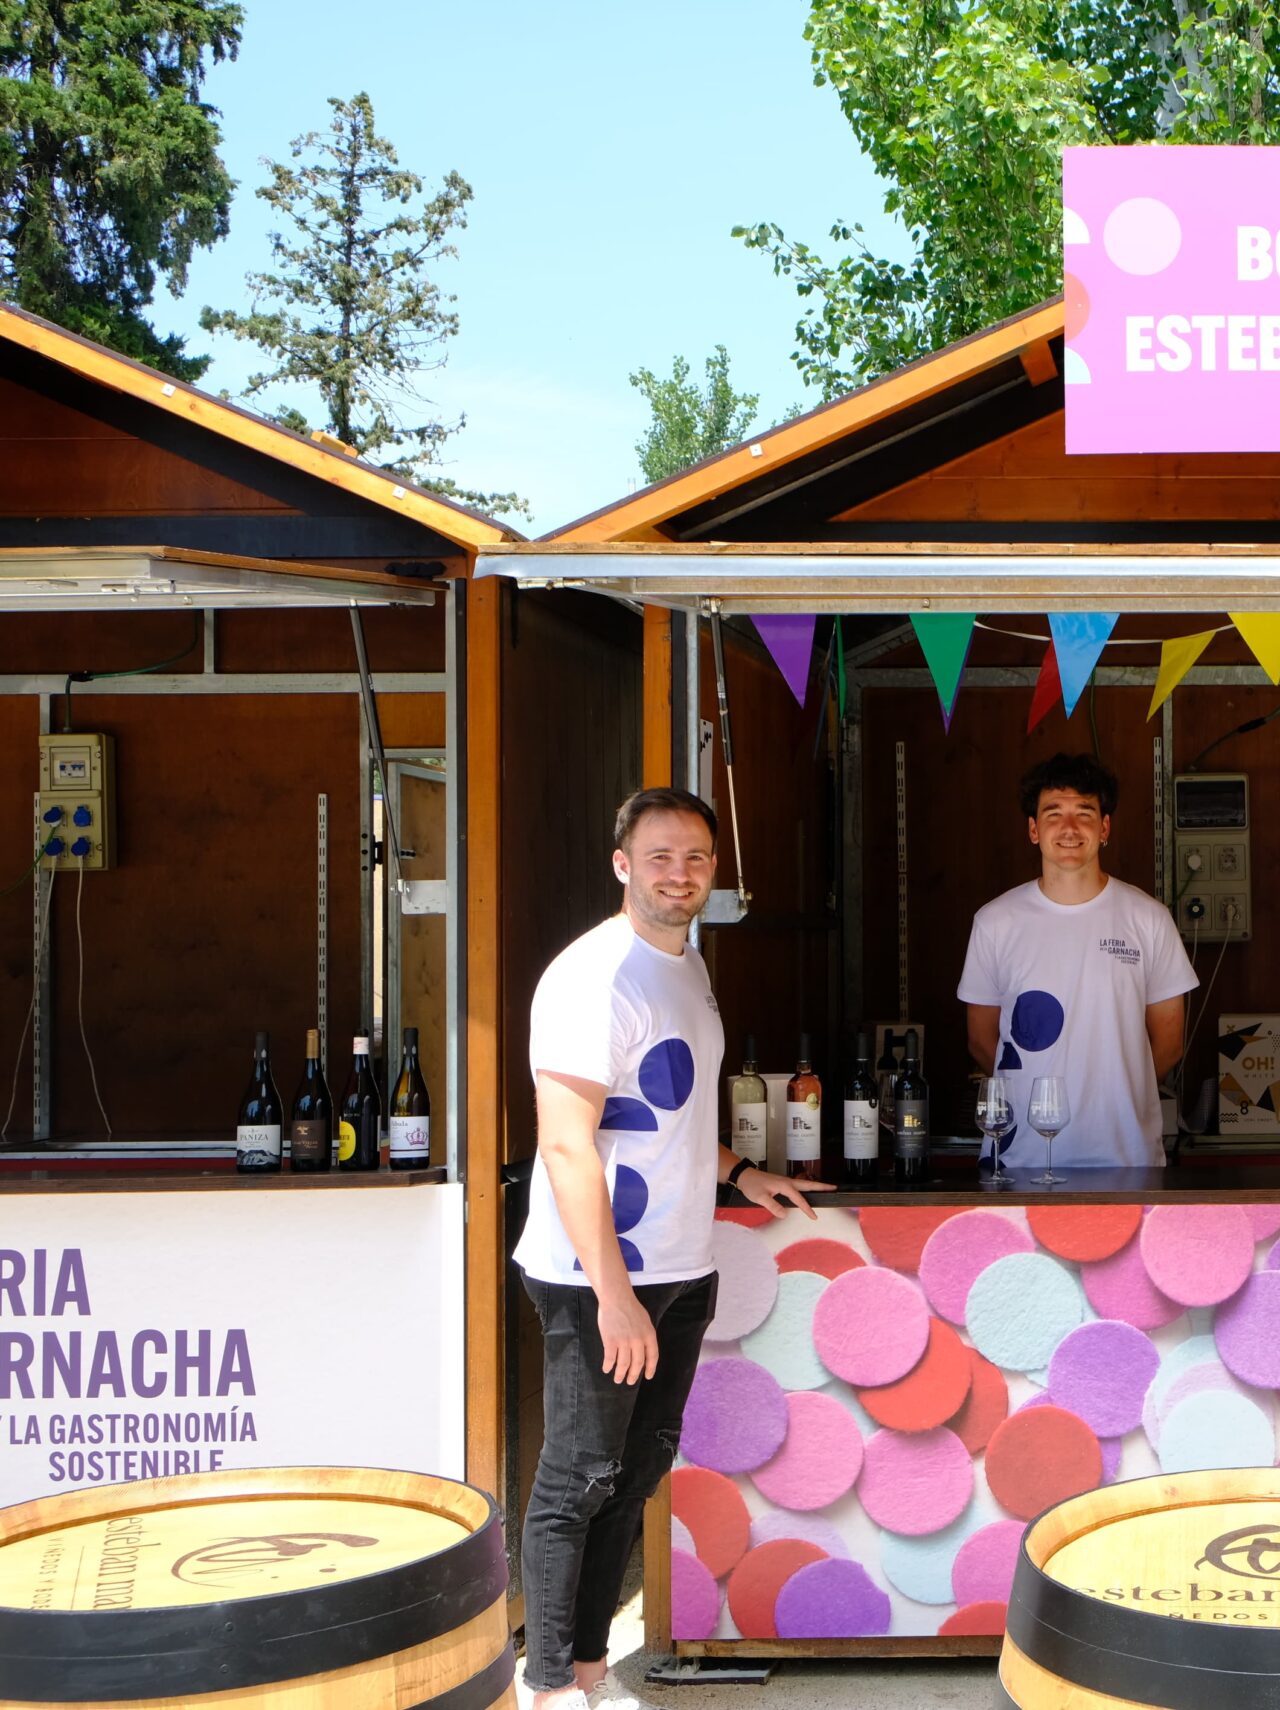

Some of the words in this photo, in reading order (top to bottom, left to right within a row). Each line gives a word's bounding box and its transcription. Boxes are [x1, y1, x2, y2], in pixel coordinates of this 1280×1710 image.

[1100, 939, 1108, 947] LA
[1108, 938, 1126, 947] FERIA
[1107, 947, 1141, 957] GARNACHA
[1241, 1056, 1275, 1071] OH!
[240, 1133, 269, 1141] PANIZA
[0, 1328, 257, 1399] RNACHA
[9, 1414, 42, 1445] LA
[49, 1405, 258, 1444] GASTRONOMÍA
[93, 1578, 136, 1610] ma
